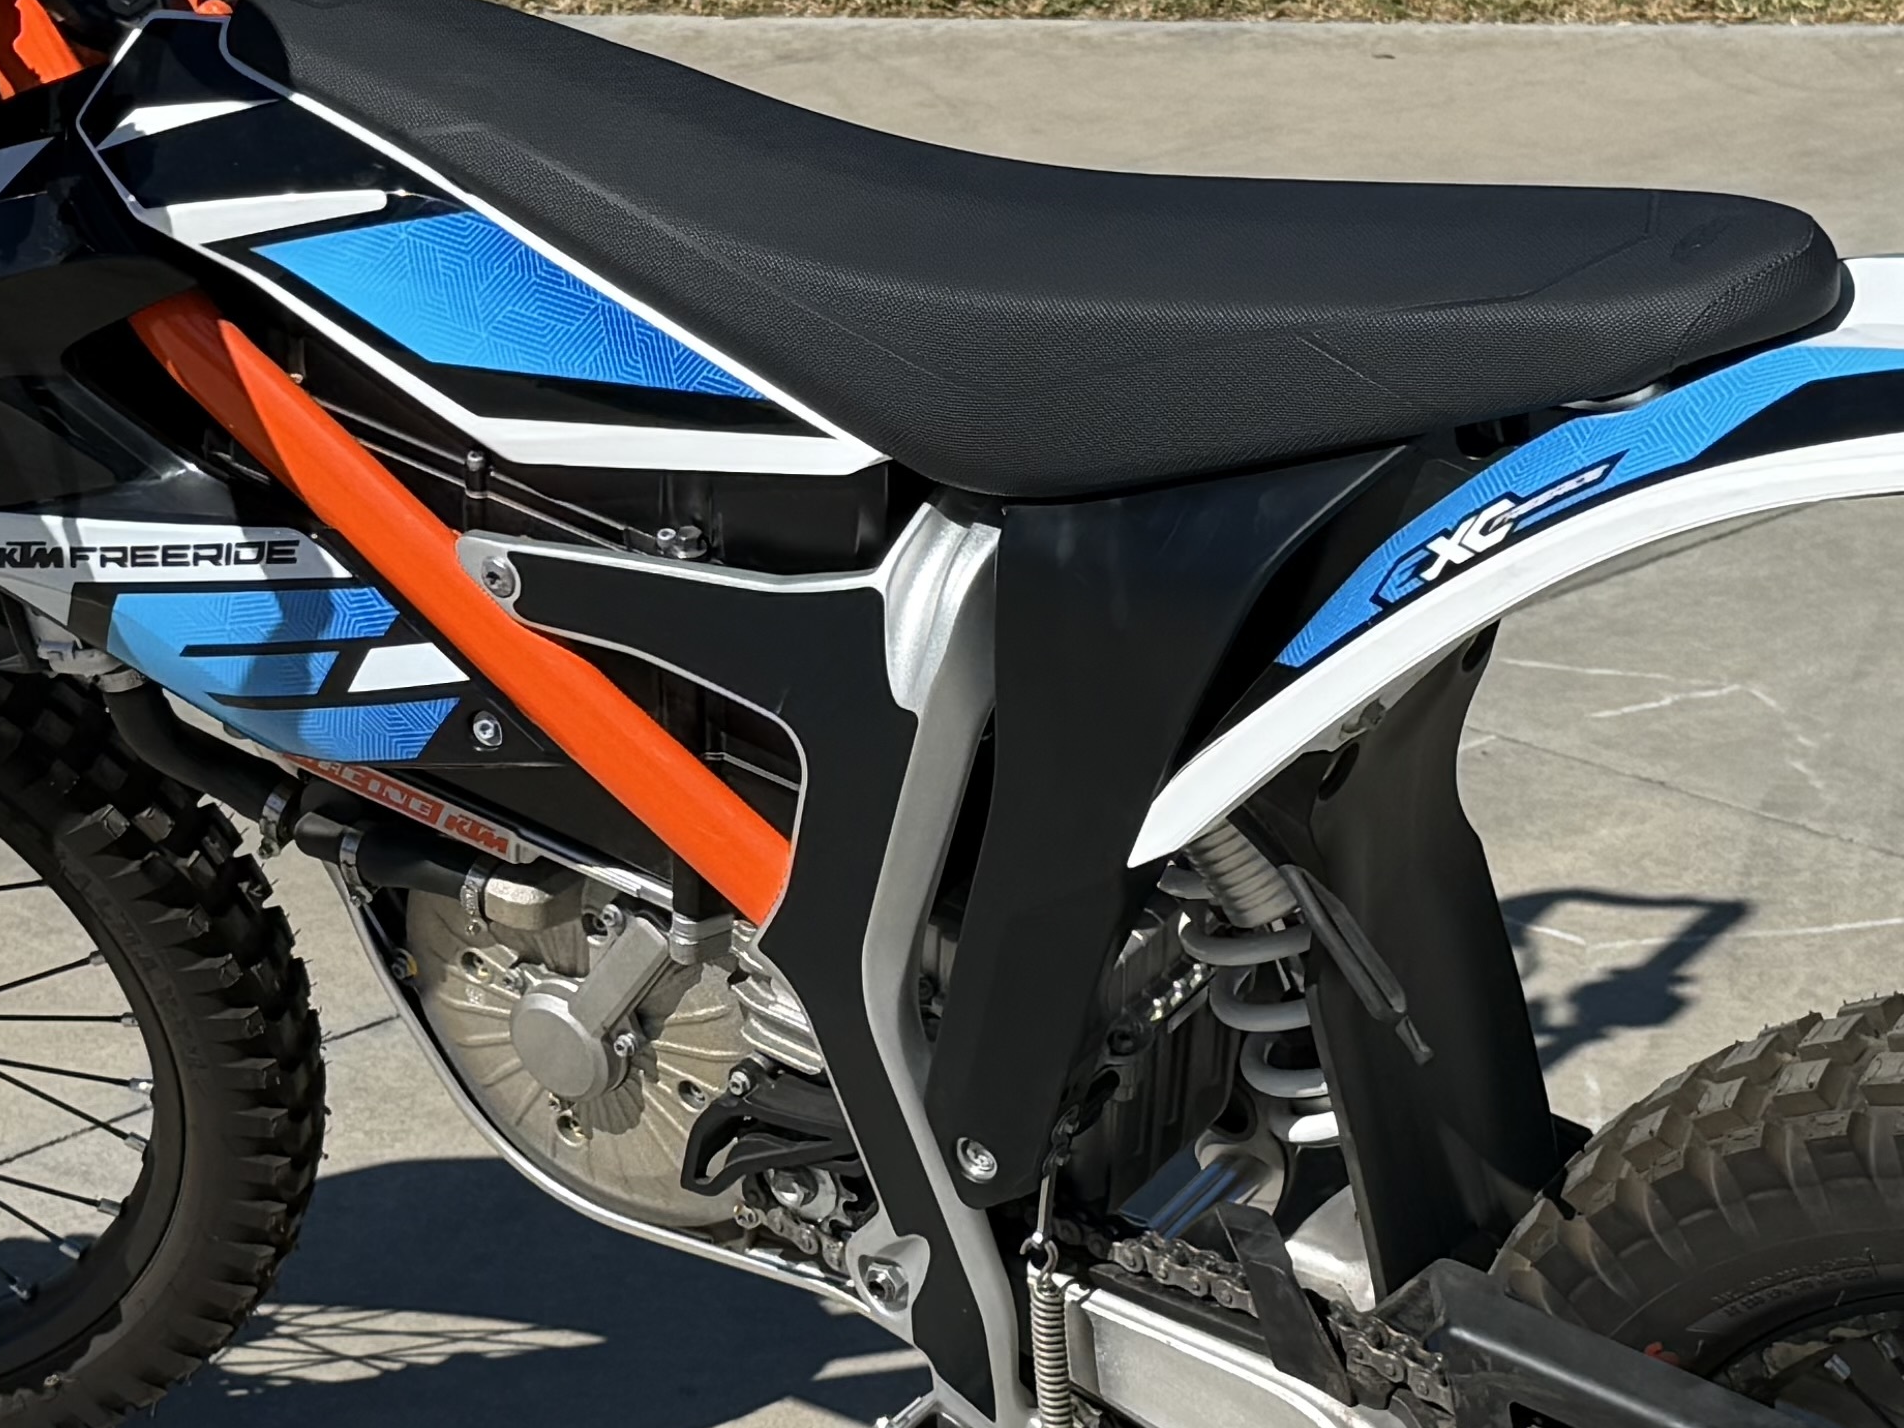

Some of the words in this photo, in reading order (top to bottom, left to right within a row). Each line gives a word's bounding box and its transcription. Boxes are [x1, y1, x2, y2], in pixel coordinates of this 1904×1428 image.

[68, 539, 300, 568] FREERIDE
[300, 758, 433, 817] ACING
[445, 813, 509, 855] KTM
